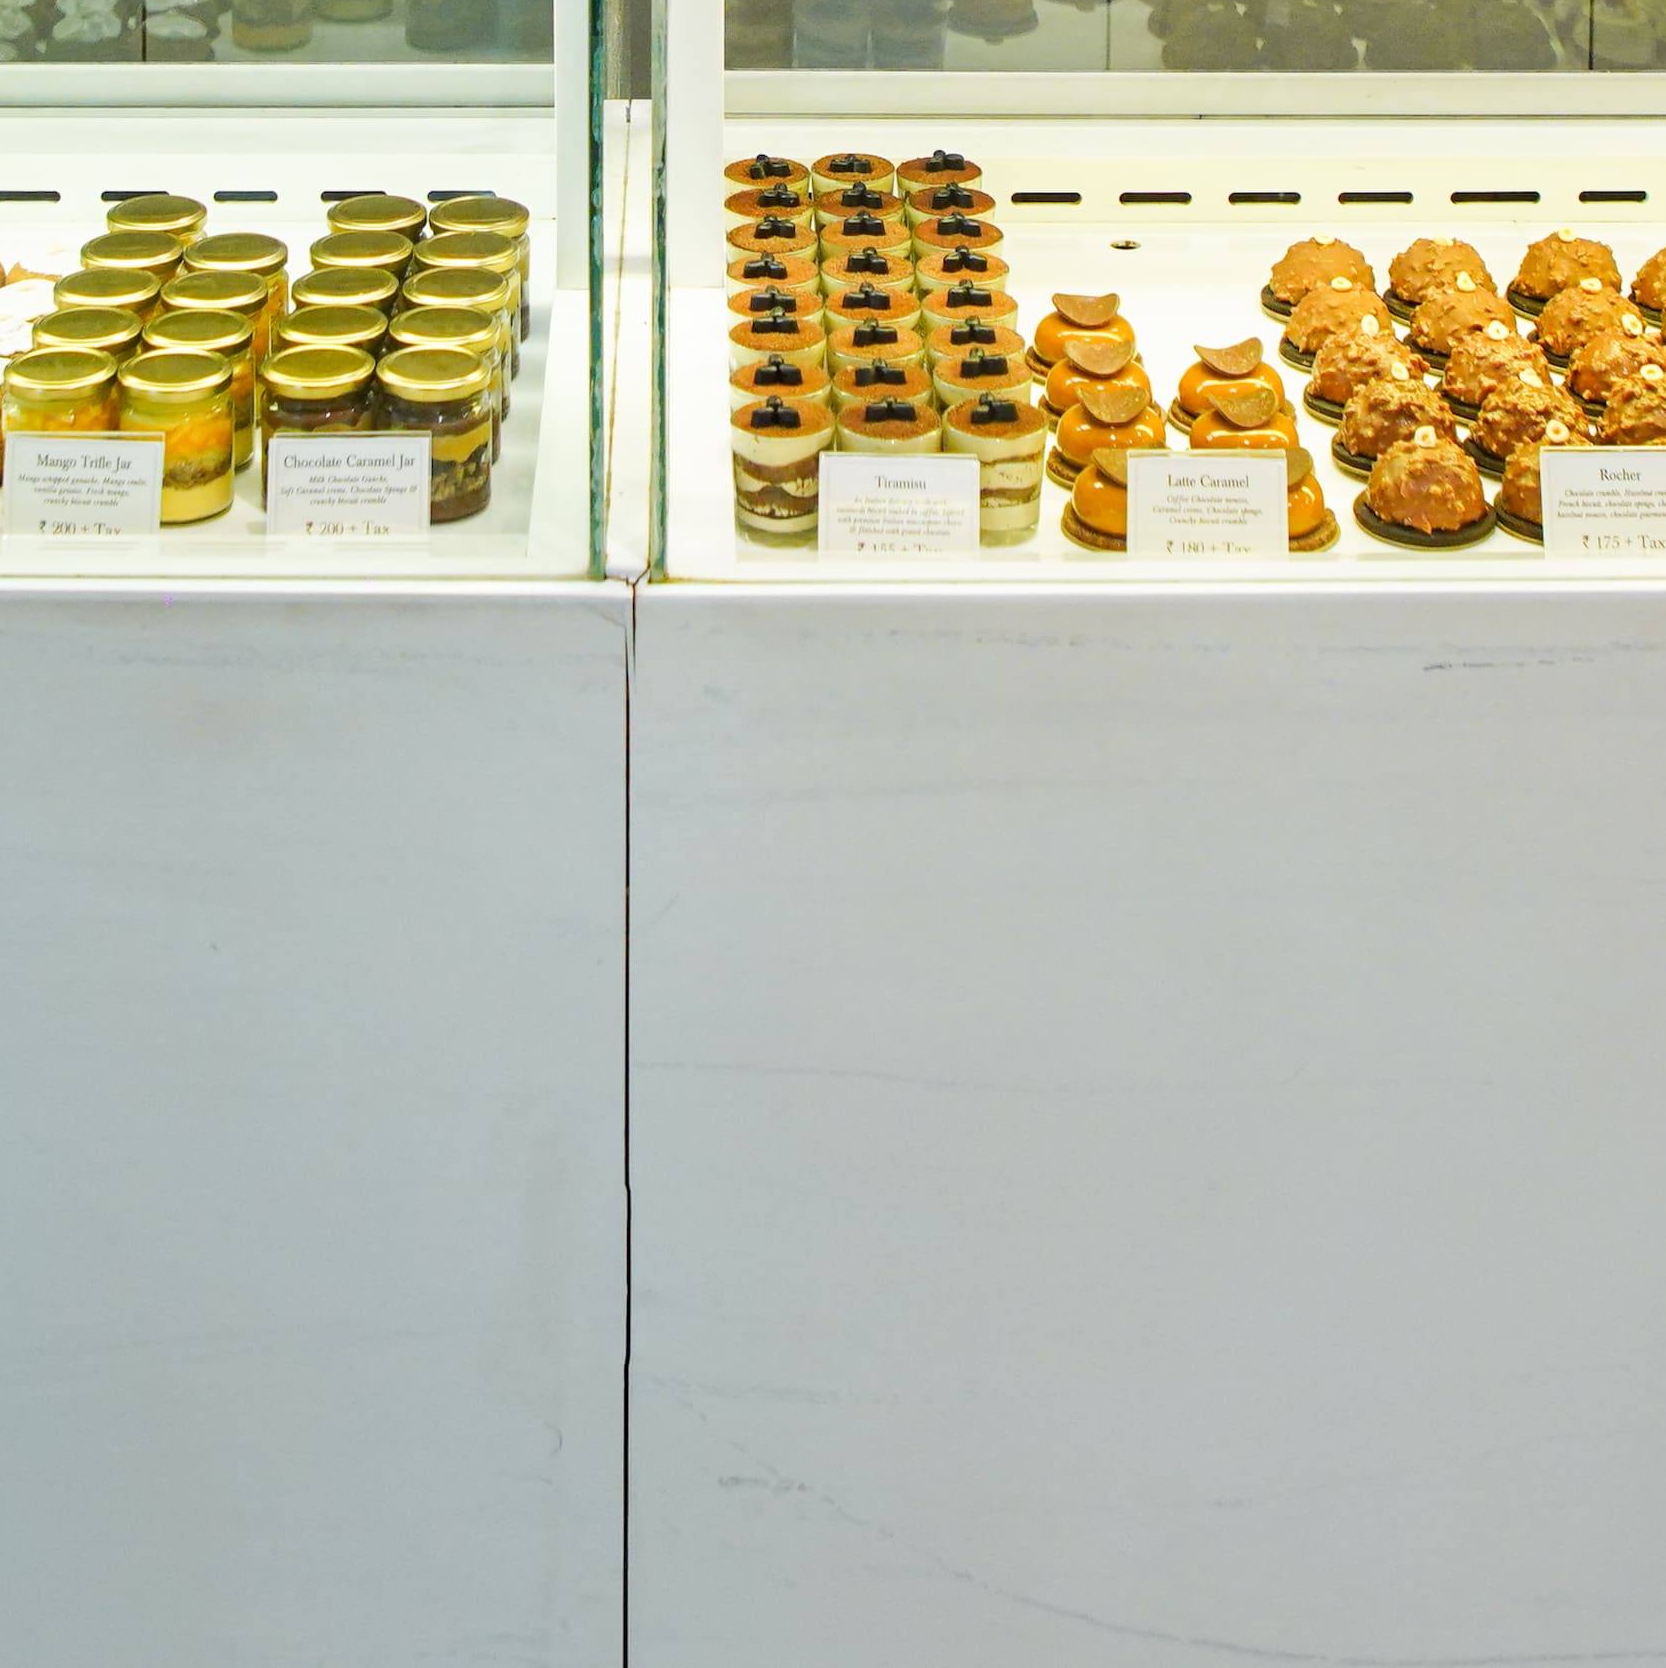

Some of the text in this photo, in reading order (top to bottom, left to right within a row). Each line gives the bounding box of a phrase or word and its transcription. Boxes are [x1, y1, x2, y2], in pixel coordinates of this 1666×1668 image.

[37, 454, 132, 473] Mango Trifle Jar
[284, 454, 416, 471] Chocolate Caramel Jar
[1168, 474, 1249, 488] Latte Caramel
[1600, 468, 1641, 481] Rocher
[875, 476, 927, 490] Tiramisu
[52, 522, 76, 534] 200
[94, 523, 121, 535] Tax
[305, 522, 313, 535] ₹
[320, 522, 344, 535] 200
[364, 522, 389, 535] Tax
[1181, 540, 1204, 553] 180
[1223, 540, 1251, 553] Tax
[1582, 535, 1666, 549] ₹ 175 + Tax
